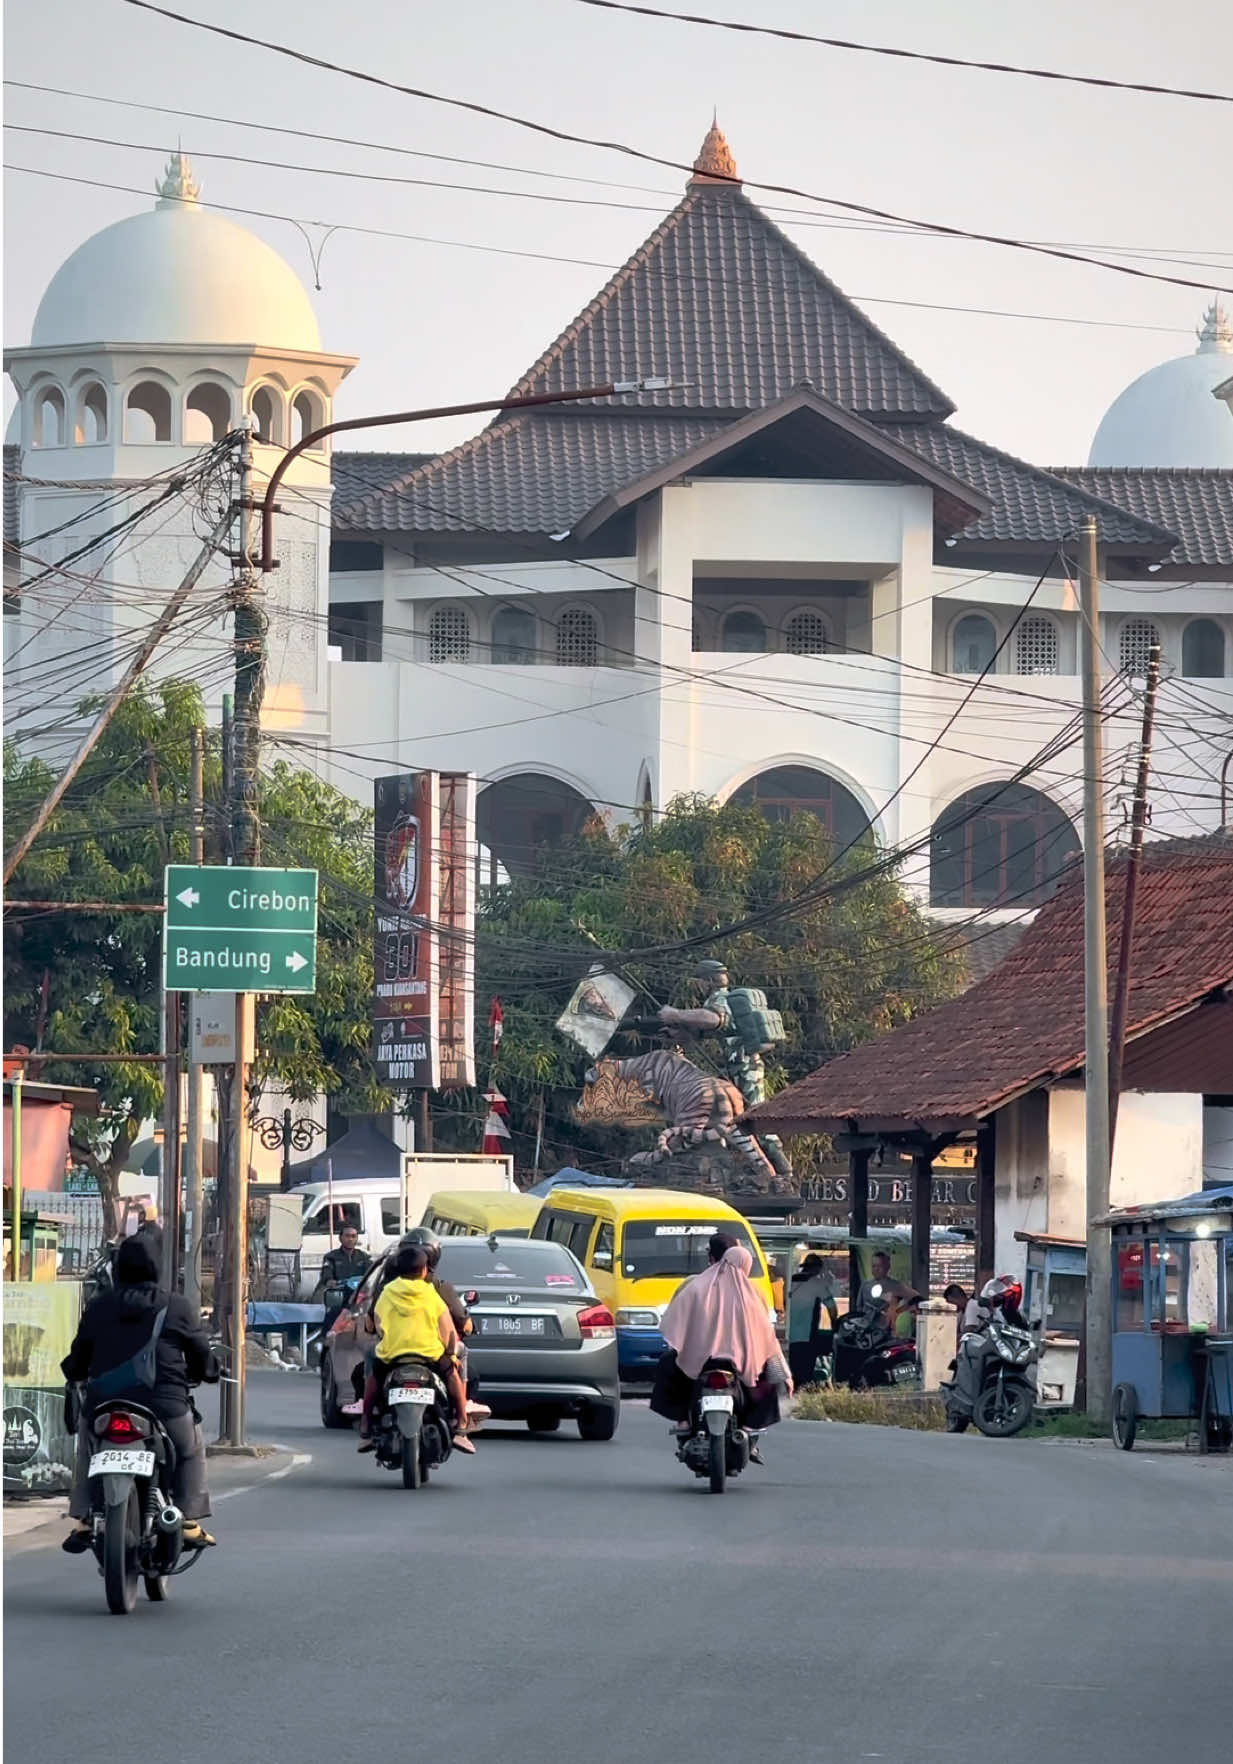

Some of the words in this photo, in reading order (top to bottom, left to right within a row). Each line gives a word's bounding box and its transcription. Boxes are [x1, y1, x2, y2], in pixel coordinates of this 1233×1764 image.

[228, 888, 310, 912] Cirebon
[176, 947, 271, 975] Bandung
[393, 1042, 428, 1061] PERKASA
[388, 1062, 415, 1079] MOTOR
[806, 1178, 880, 1201] MESD
[892, 1179, 955, 1203] BEAR
